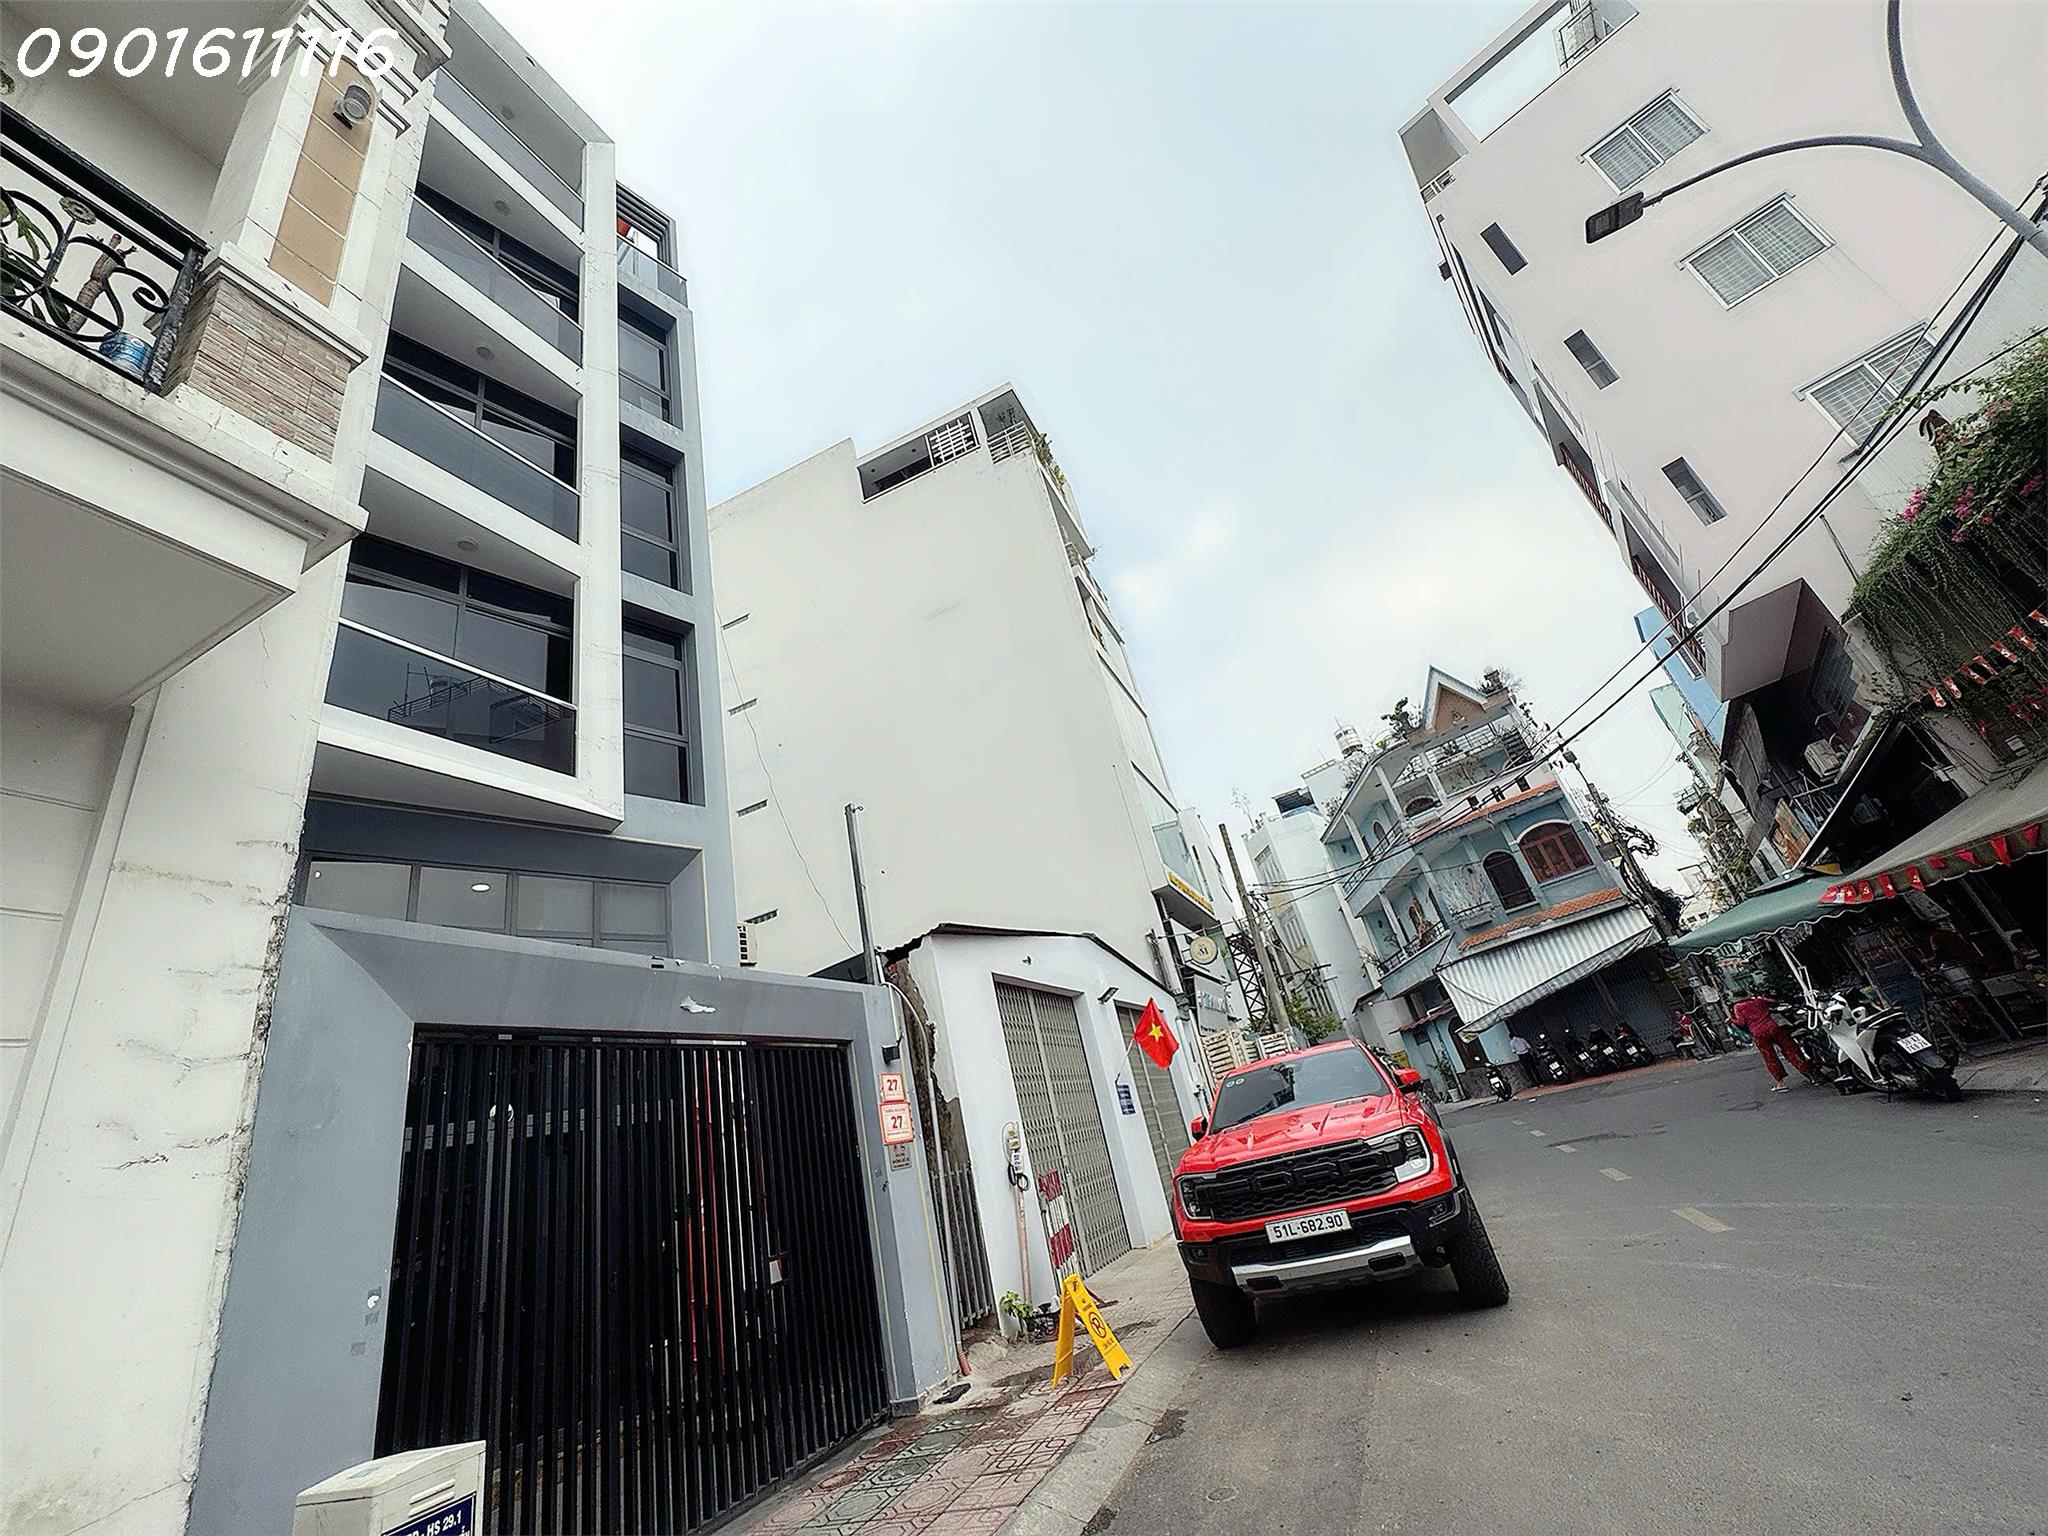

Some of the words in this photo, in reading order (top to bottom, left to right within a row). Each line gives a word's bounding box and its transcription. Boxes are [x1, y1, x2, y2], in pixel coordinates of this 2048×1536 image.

[886, 1079, 898, 1091] 27
[891, 1115, 903, 1129] 27
[442, 1510, 462, 1532] 29.1
